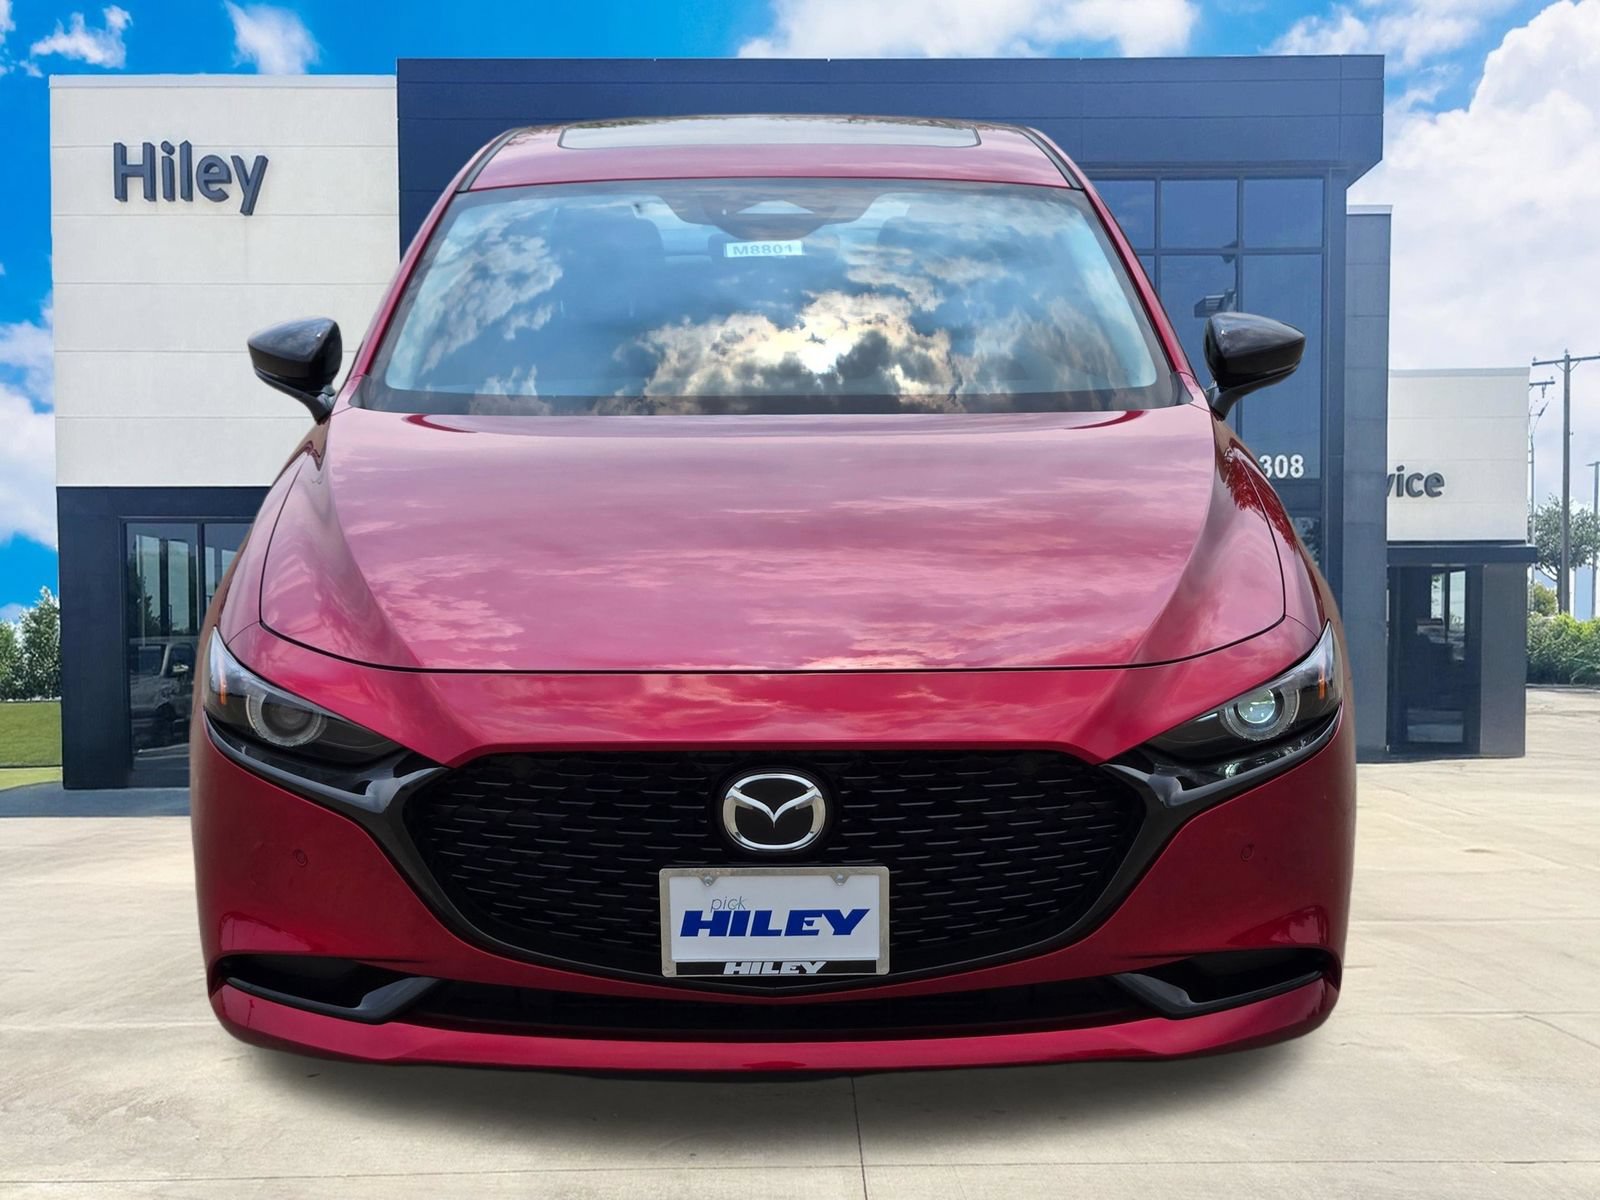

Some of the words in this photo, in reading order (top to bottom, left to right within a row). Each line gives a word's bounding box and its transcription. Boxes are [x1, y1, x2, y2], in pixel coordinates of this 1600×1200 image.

[113, 140, 269, 216] Hiley
[732, 244, 793, 256] M8801
[1259, 454, 1304, 478] 308
[710, 896, 746, 912] pick
[680, 909, 870, 937] HILEY
[723, 961, 827, 975] HILEY
